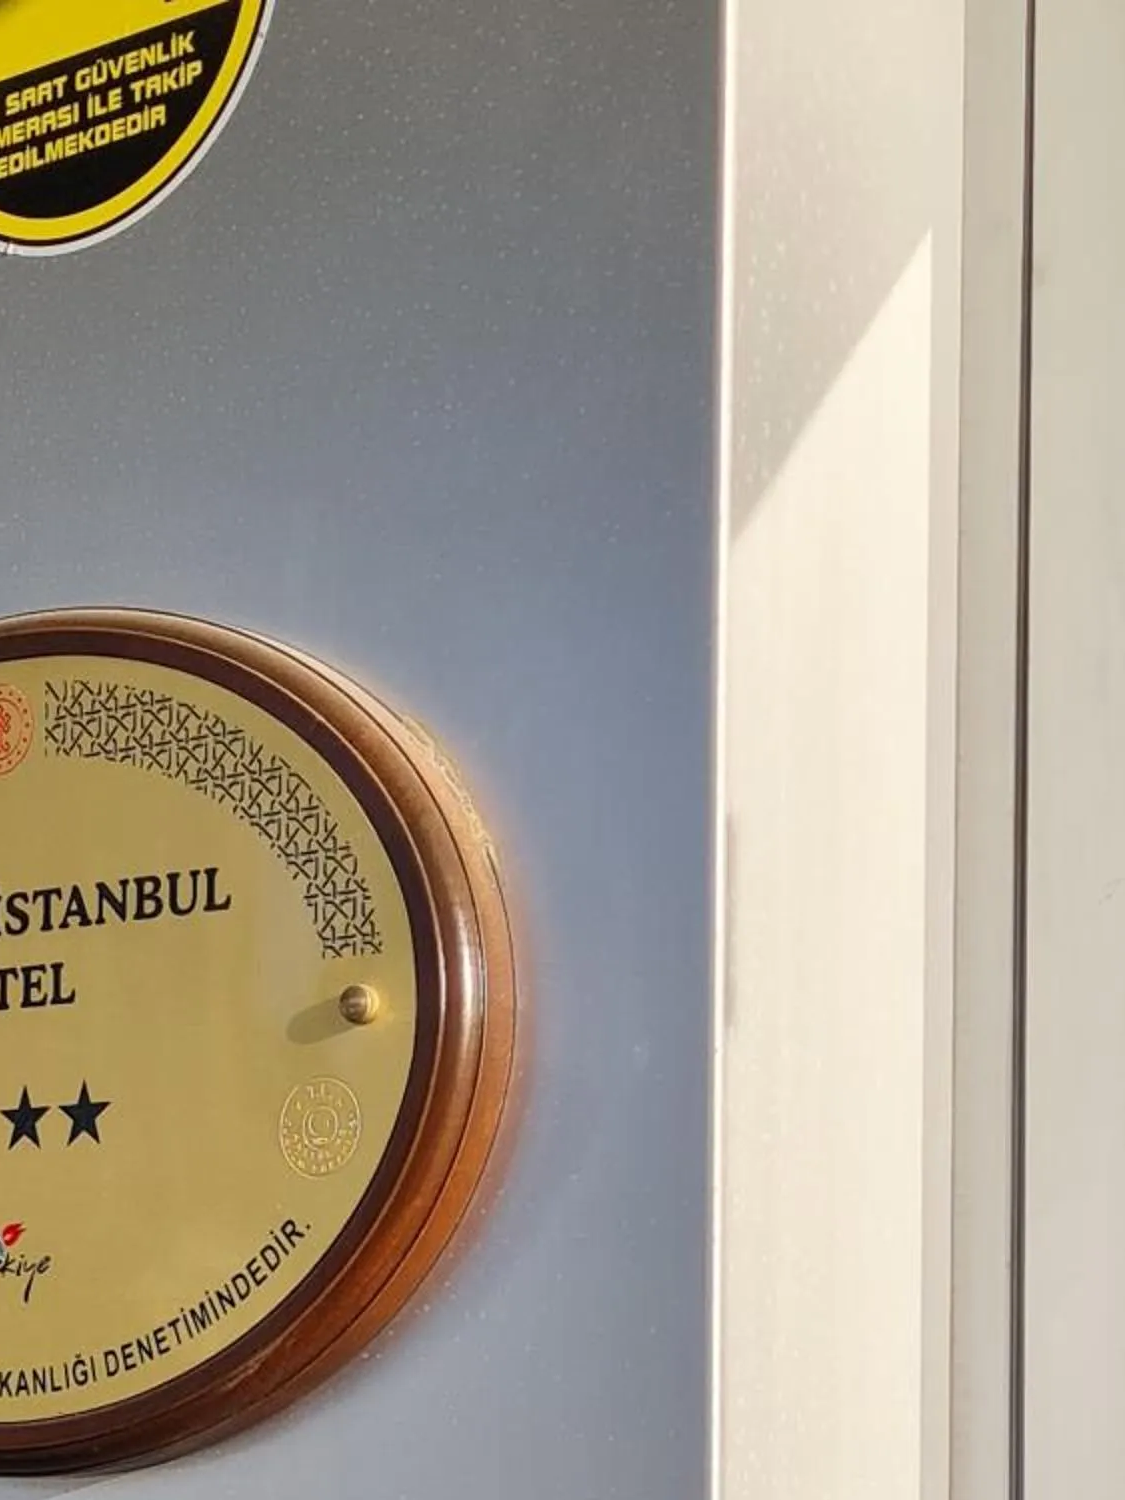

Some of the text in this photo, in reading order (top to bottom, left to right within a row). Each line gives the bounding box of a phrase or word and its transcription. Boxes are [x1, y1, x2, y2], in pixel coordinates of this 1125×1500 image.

[5, 74, 68, 117] SAAT
[75, 31, 195, 92] GÜVENLİK
[86, 92, 122, 119] İLE
[129, 60, 203, 104] TAKİP
[103, 1218, 312, 1379] DENETİMİNDEDİR.
